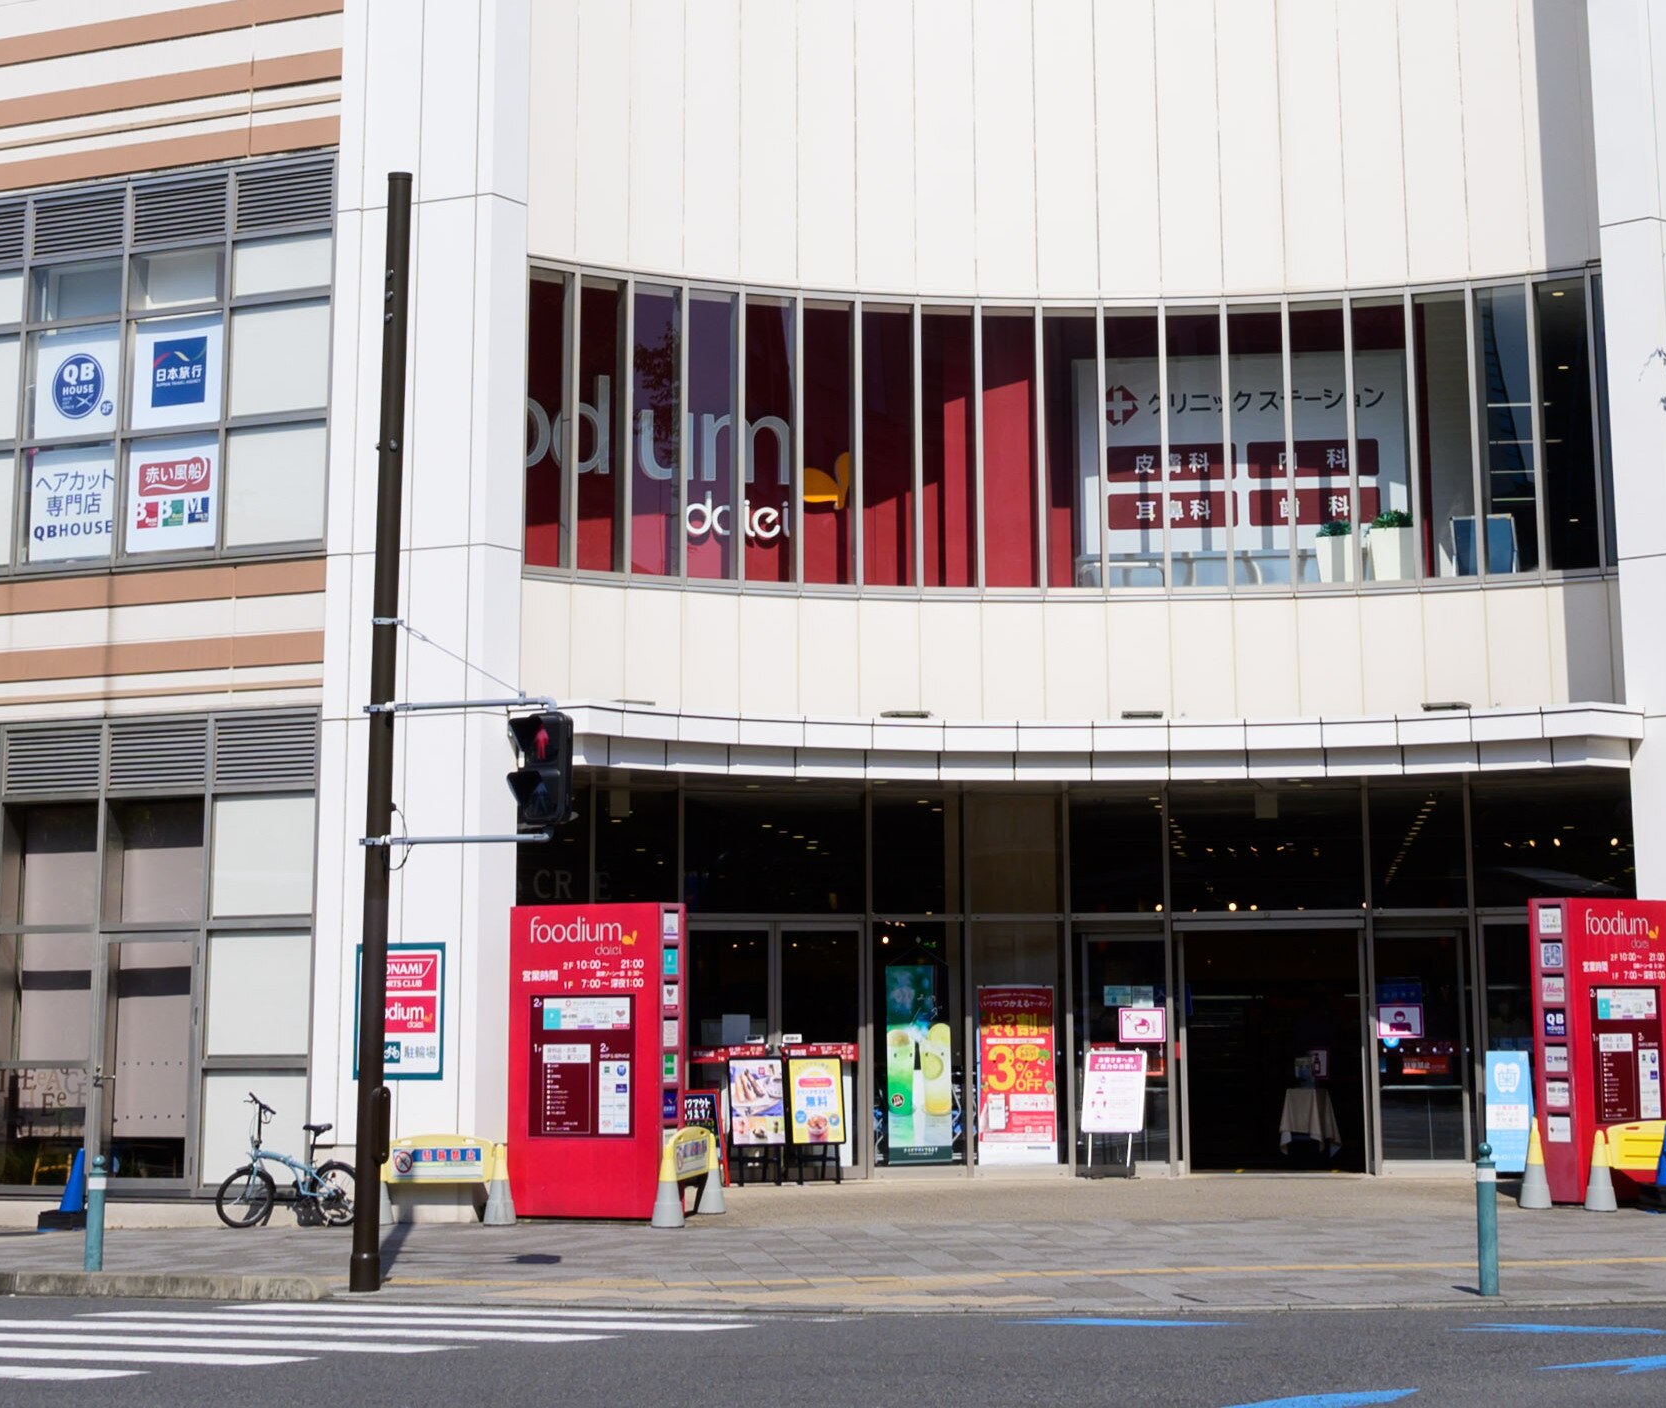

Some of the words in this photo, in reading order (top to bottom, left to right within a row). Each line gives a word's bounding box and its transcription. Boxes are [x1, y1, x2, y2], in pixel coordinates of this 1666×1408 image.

[63, 362, 94, 384] QB
[156, 365, 202, 382] 日本旅行
[62, 384, 94, 396] HOUSE
[102, 403, 112, 414] 2F
[1134, 452, 1209, 474] 皮膚科
[36, 469, 114, 492] ヘアカット
[145, 463, 202, 484] 赤い風船
[46, 493, 101, 517] 専門店
[1136, 499, 1211, 521] 耳鼻科
[530, 916, 622, 943] foodium
[1586, 909, 1649, 935] foodium
[595, 944, 622, 956] daiei
[1649, 952, 1665, 961] 21:00
[563, 962, 573, 970] 2F
[621, 959, 644, 968] 21:00
[564, 981, 573, 989] 1F
[1546, 1013, 1564, 1025] QB
[1016, 1079, 1043, 1091] OFF
